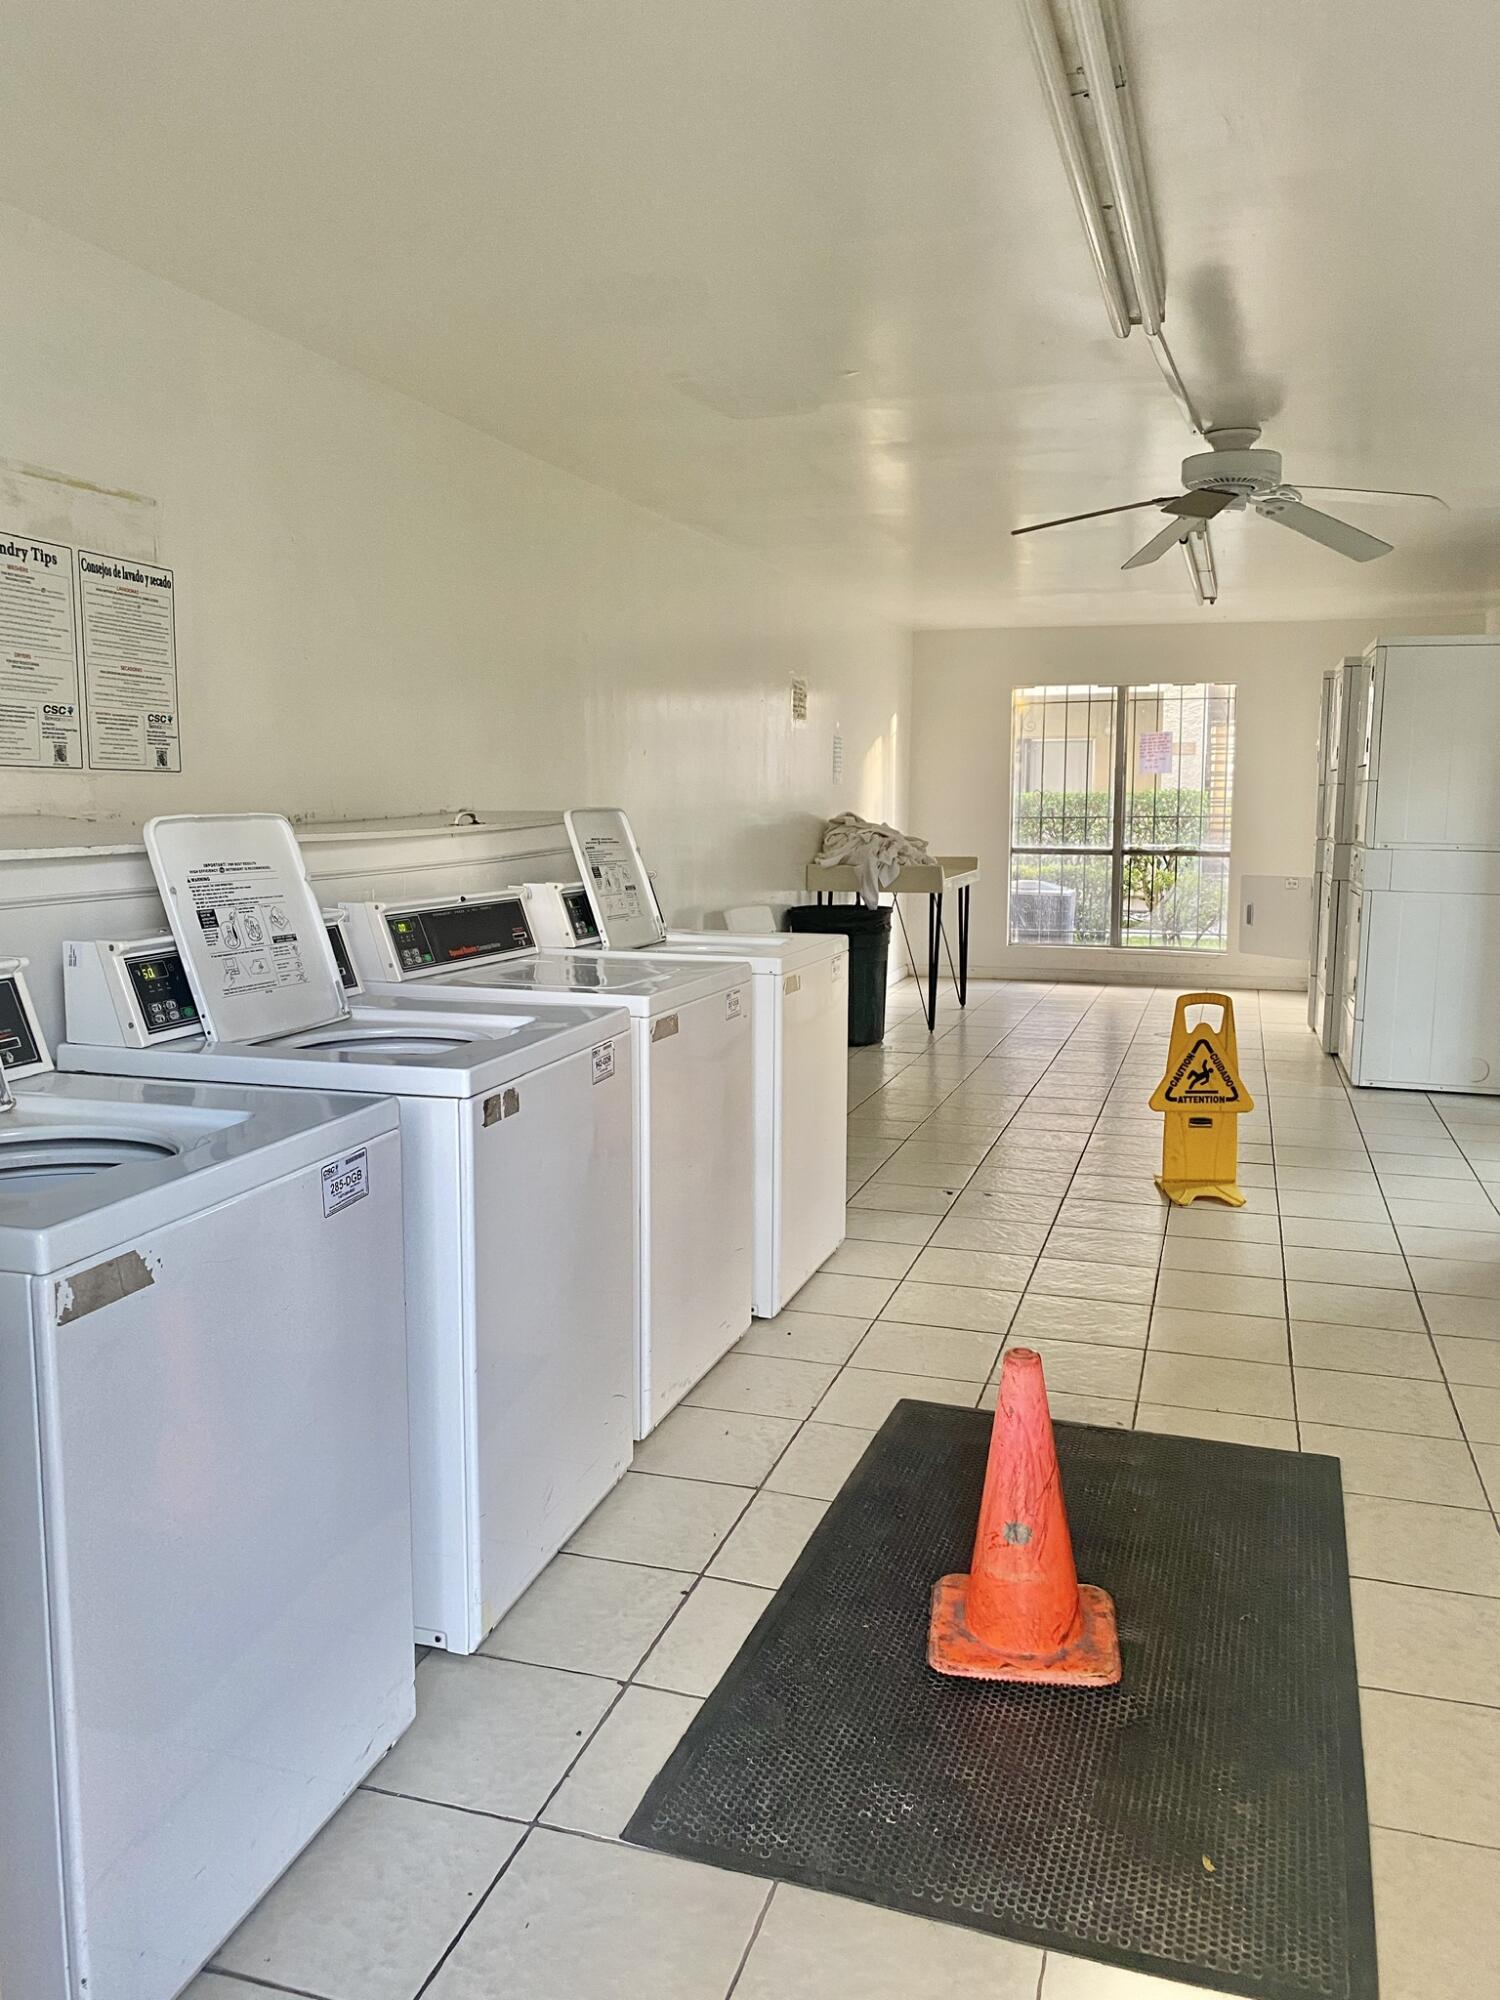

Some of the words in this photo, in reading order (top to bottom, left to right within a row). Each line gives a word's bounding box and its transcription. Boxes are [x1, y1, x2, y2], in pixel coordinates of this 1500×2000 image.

[31, 547, 58, 567] Tips
[81, 557, 112, 579] Consejos
[113, 565, 122, 579] de
[122, 566, 144, 583] lavado
[150, 575, 172, 589] secado
[43, 704, 67, 715] CSC
[147, 713, 167, 724] CSC
[1170, 1053, 1195, 1087] CAUTION
[1210, 1053, 1234, 1087] CUIDADO
[1177, 1096, 1225, 1104] ATTENTION
[330, 1169, 362, 1195] 285-DGB
